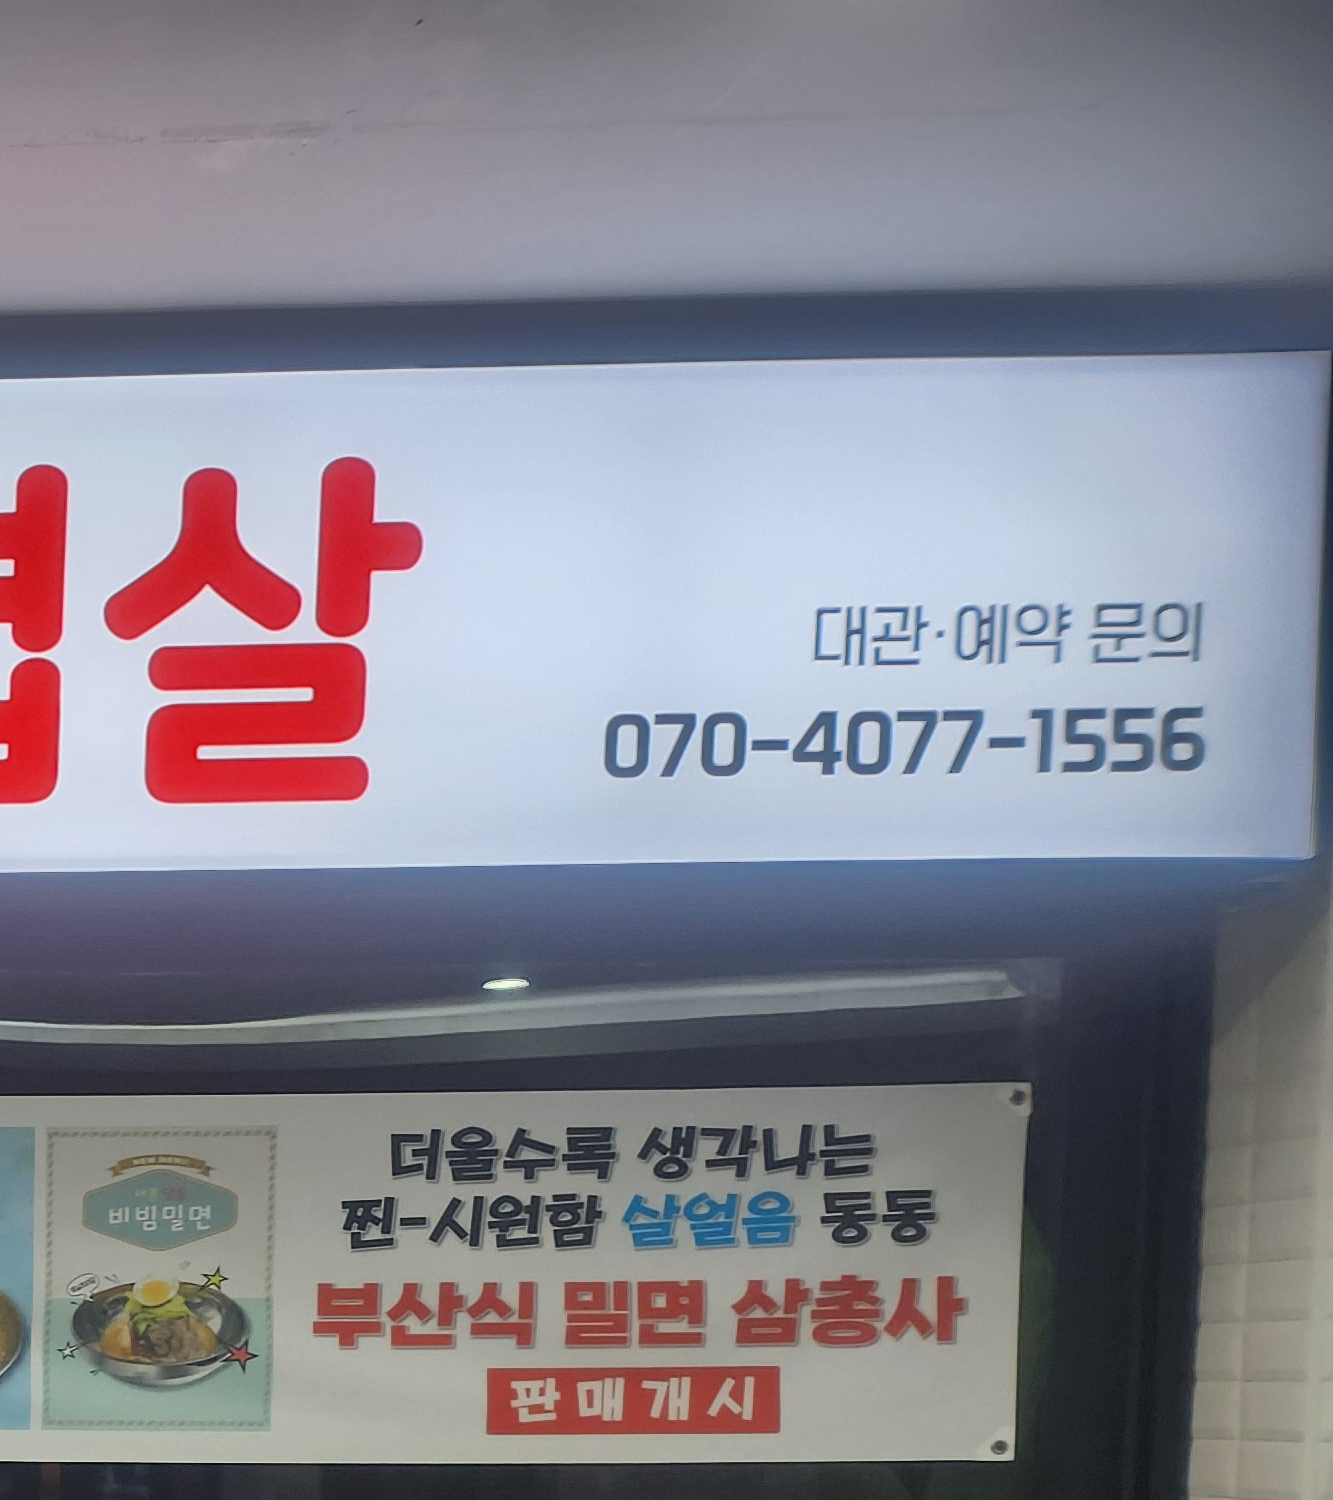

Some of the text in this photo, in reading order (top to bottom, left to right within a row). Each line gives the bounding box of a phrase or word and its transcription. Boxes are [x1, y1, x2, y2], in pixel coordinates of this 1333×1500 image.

[813, 602, 1204, 667] 대관·예약 문의
[603, 706, 1206, 779] 070-4077-1556
[389, 1123, 877, 1183] 더울수록 생각나는
[107, 1203, 213, 1233] 비빔밀면
[340, 1189, 937, 1250] 찐-시원함 살얼음 동동
[312, 1275, 968, 1349] 부산식 밀면 삼총사
[510, 1376, 757, 1422] 판매개시
